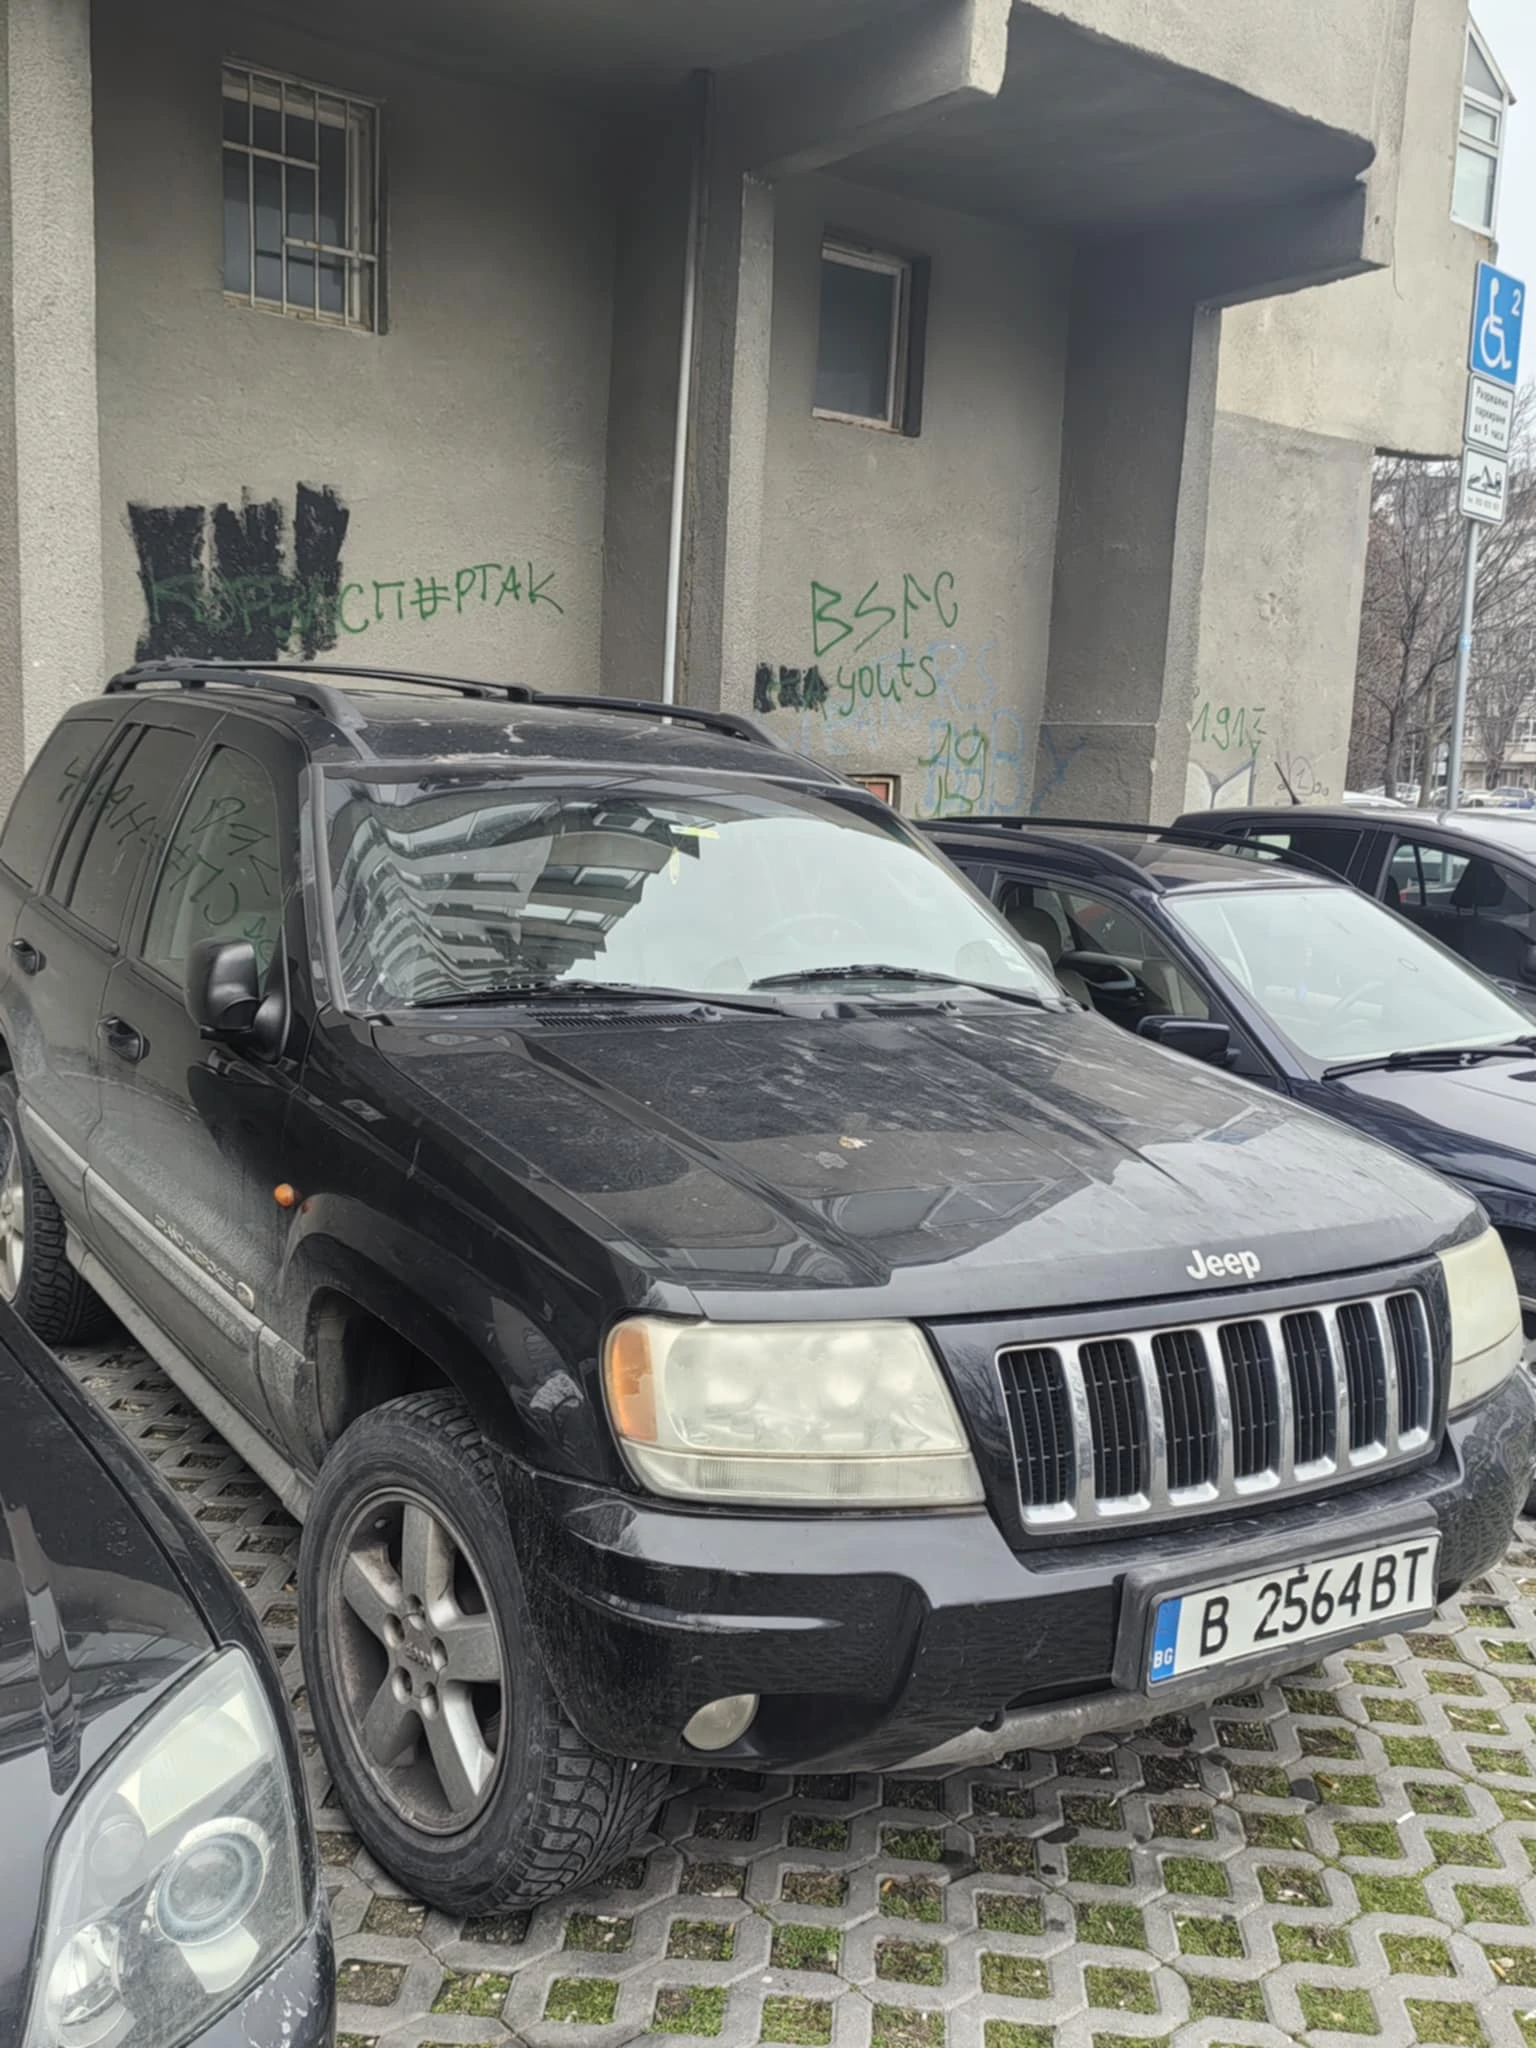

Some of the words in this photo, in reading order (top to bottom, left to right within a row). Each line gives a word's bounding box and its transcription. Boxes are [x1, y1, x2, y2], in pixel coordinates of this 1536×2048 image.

[1511, 288, 1521, 317] 2
[1185, 1248, 1261, 1280] Jeep
[1199, 1595, 1229, 1657] B
[1152, 1647, 1173, 1669] BG
